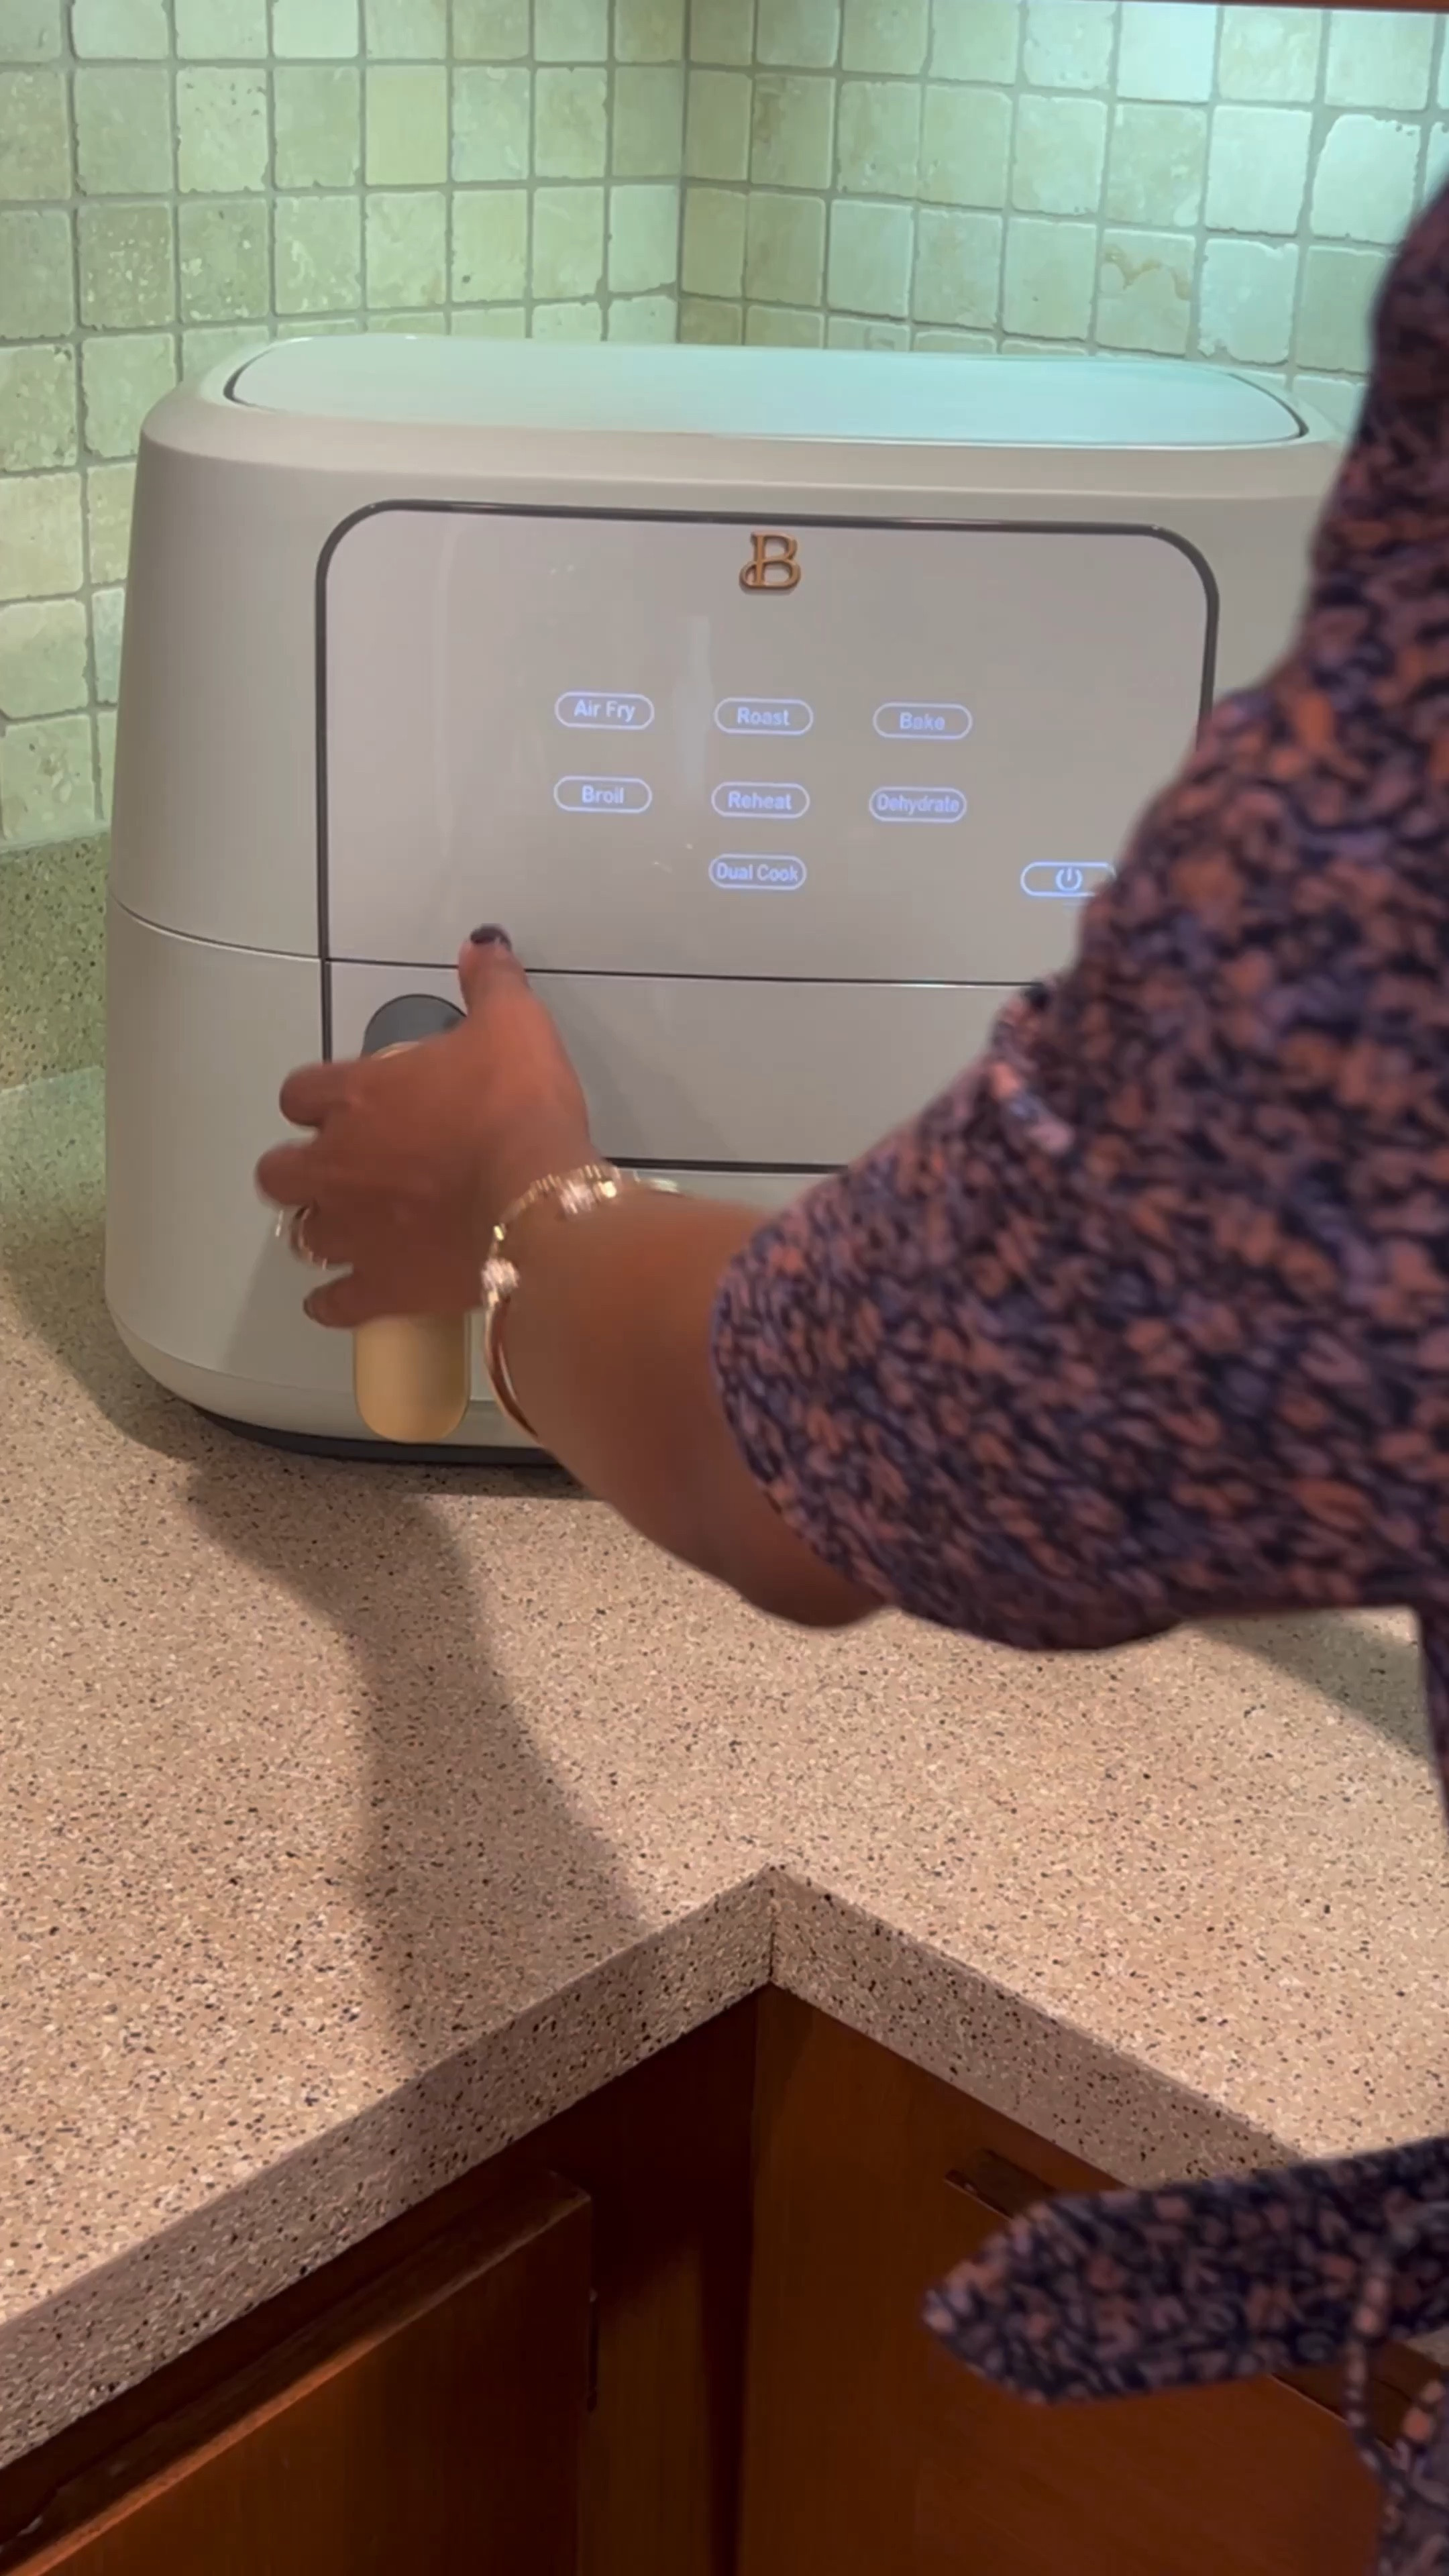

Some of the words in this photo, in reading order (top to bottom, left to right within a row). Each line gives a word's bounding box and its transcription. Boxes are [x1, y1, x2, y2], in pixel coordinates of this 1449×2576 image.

[739, 531, 801, 590] B
[574, 700, 602, 718] Air
[606, 701, 636, 722] Fry
[737, 706, 790, 727] Roast
[900, 712, 945, 731] Bake
[582, 786, 625, 805] Broil
[728, 792, 792, 810] Reheat
[876, 794, 960, 815] Dehydrate
[716, 863, 753, 881] Dual
[757, 864, 798, 881] Cook
